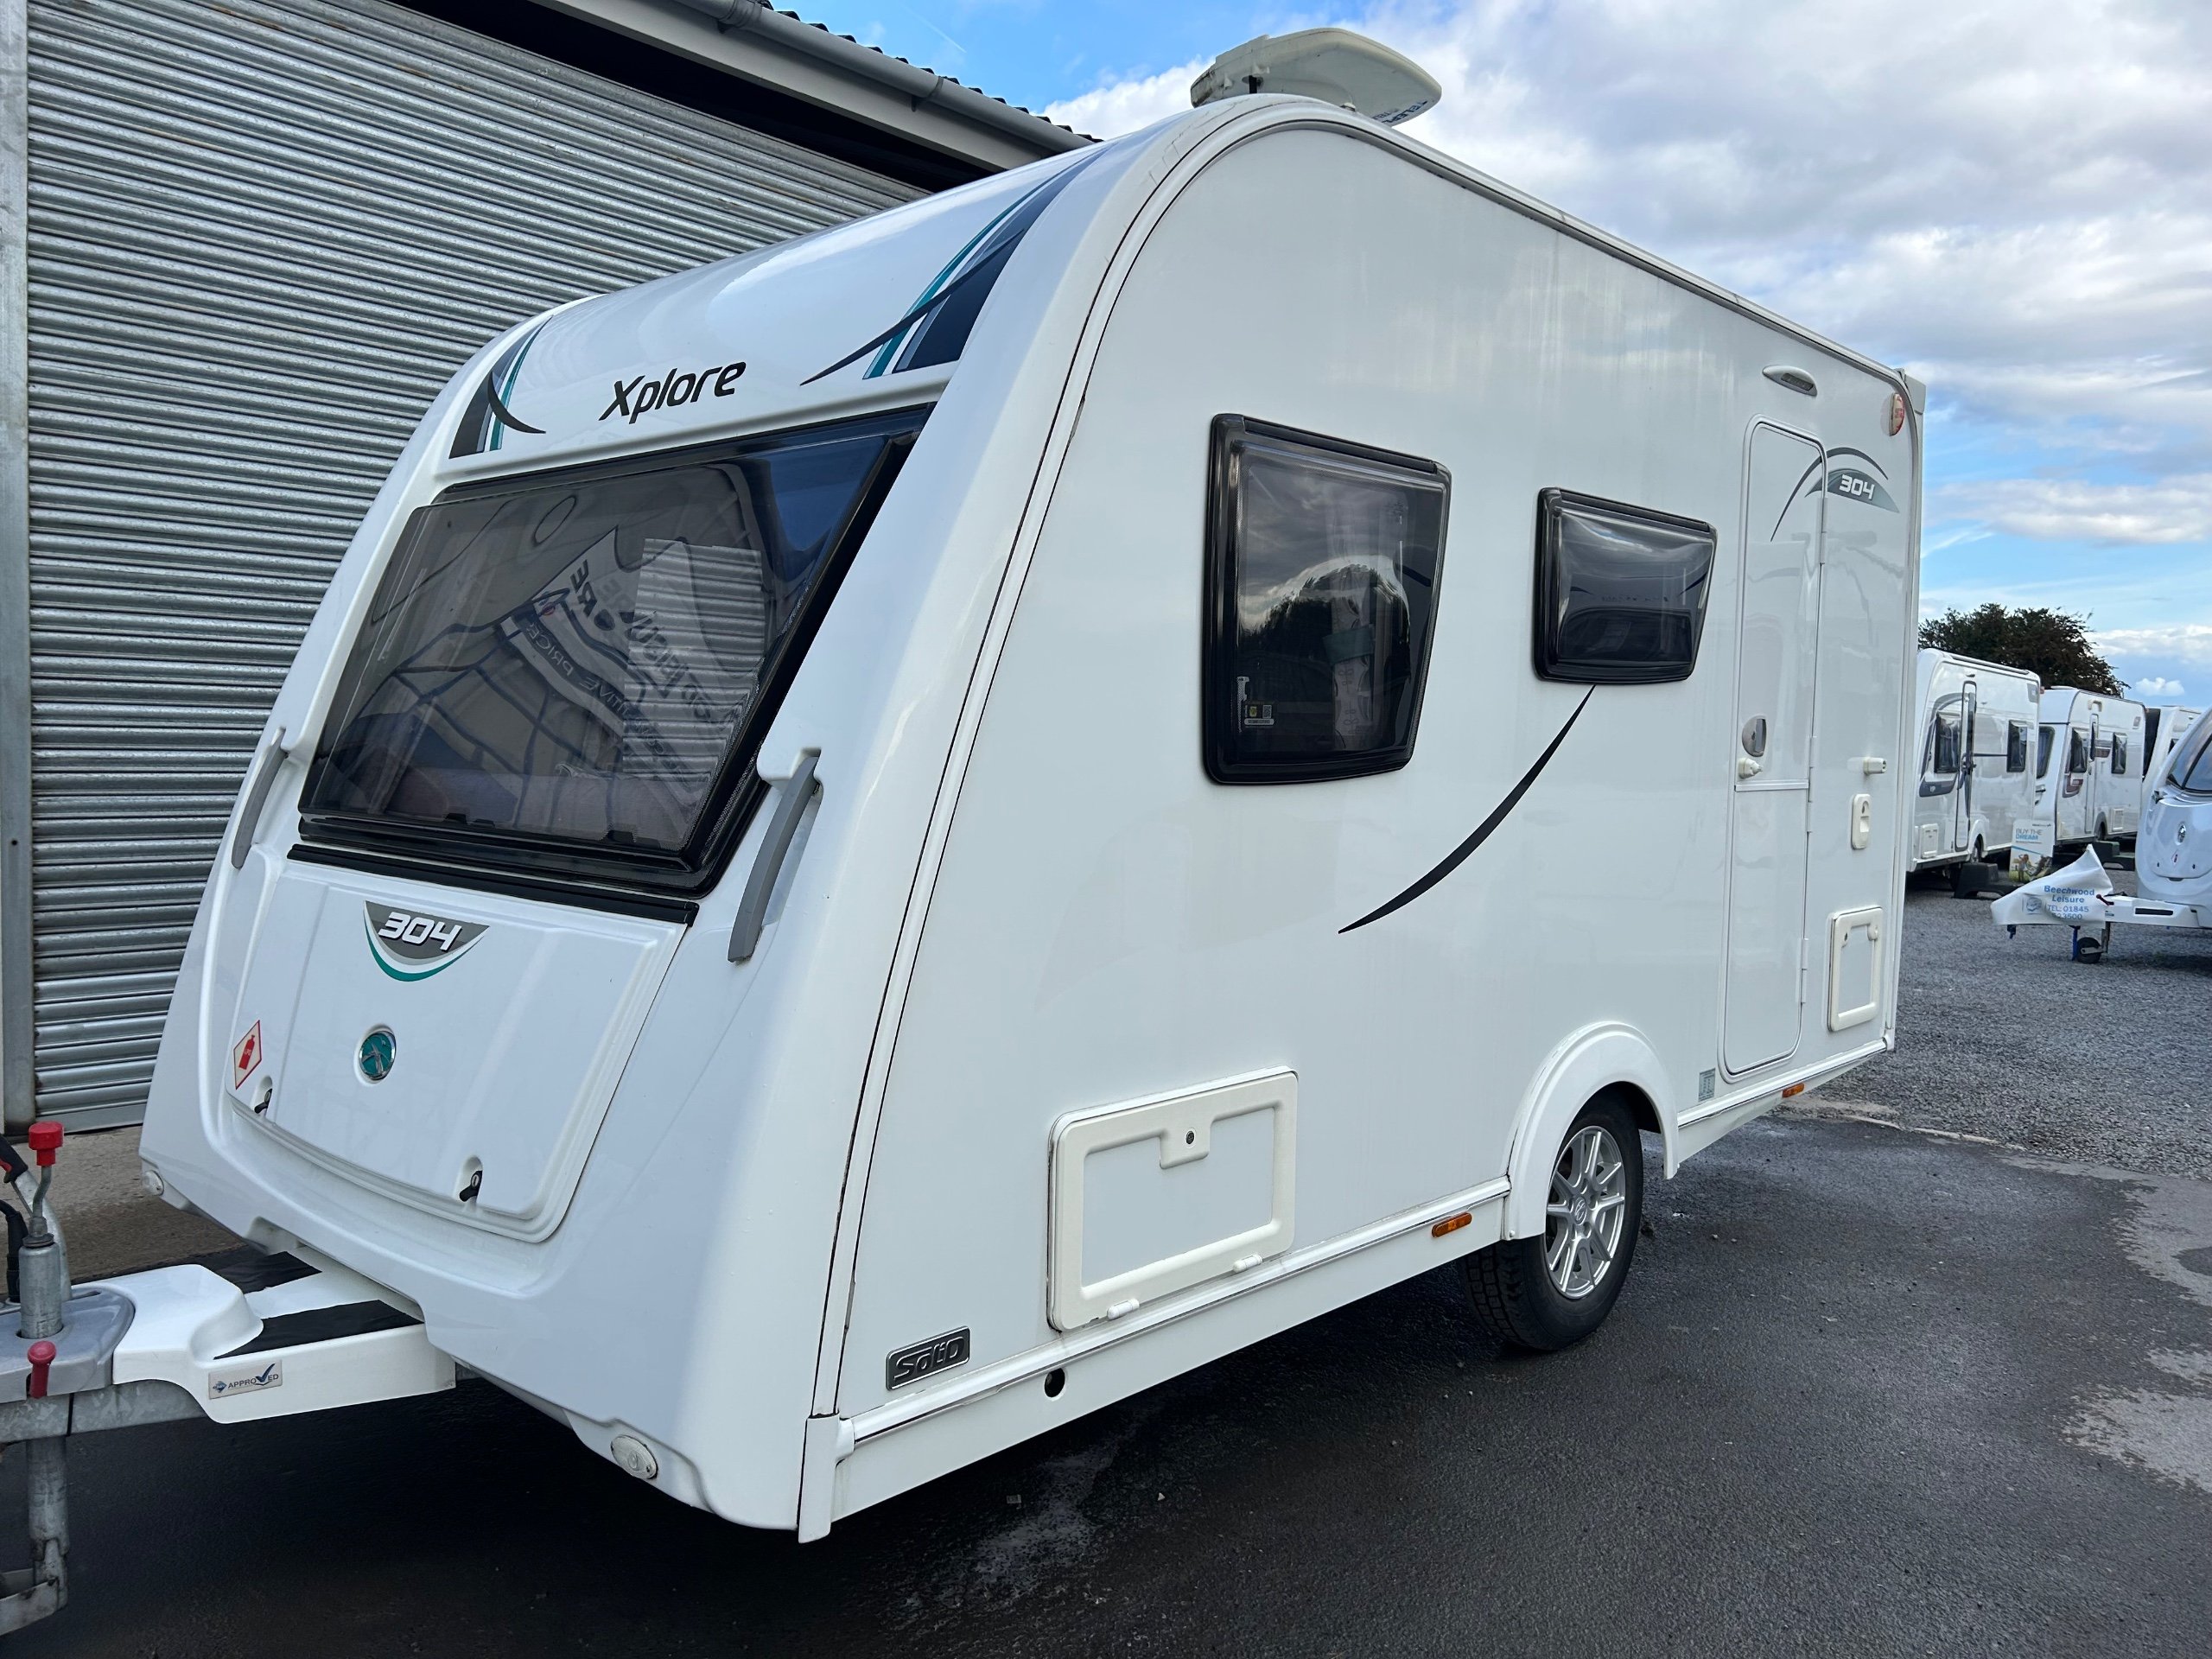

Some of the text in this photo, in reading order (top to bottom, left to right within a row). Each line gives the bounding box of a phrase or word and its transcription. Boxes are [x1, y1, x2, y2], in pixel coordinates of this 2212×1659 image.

[598, 361, 747, 424] Xplore
[1839, 474, 1875, 500] 304
[2044, 885, 2095, 896] Beechwood
[2051, 894, 2085, 903] Leisure
[378, 912, 463, 953] 304
[227, 1363, 279, 1389] APPROVED
